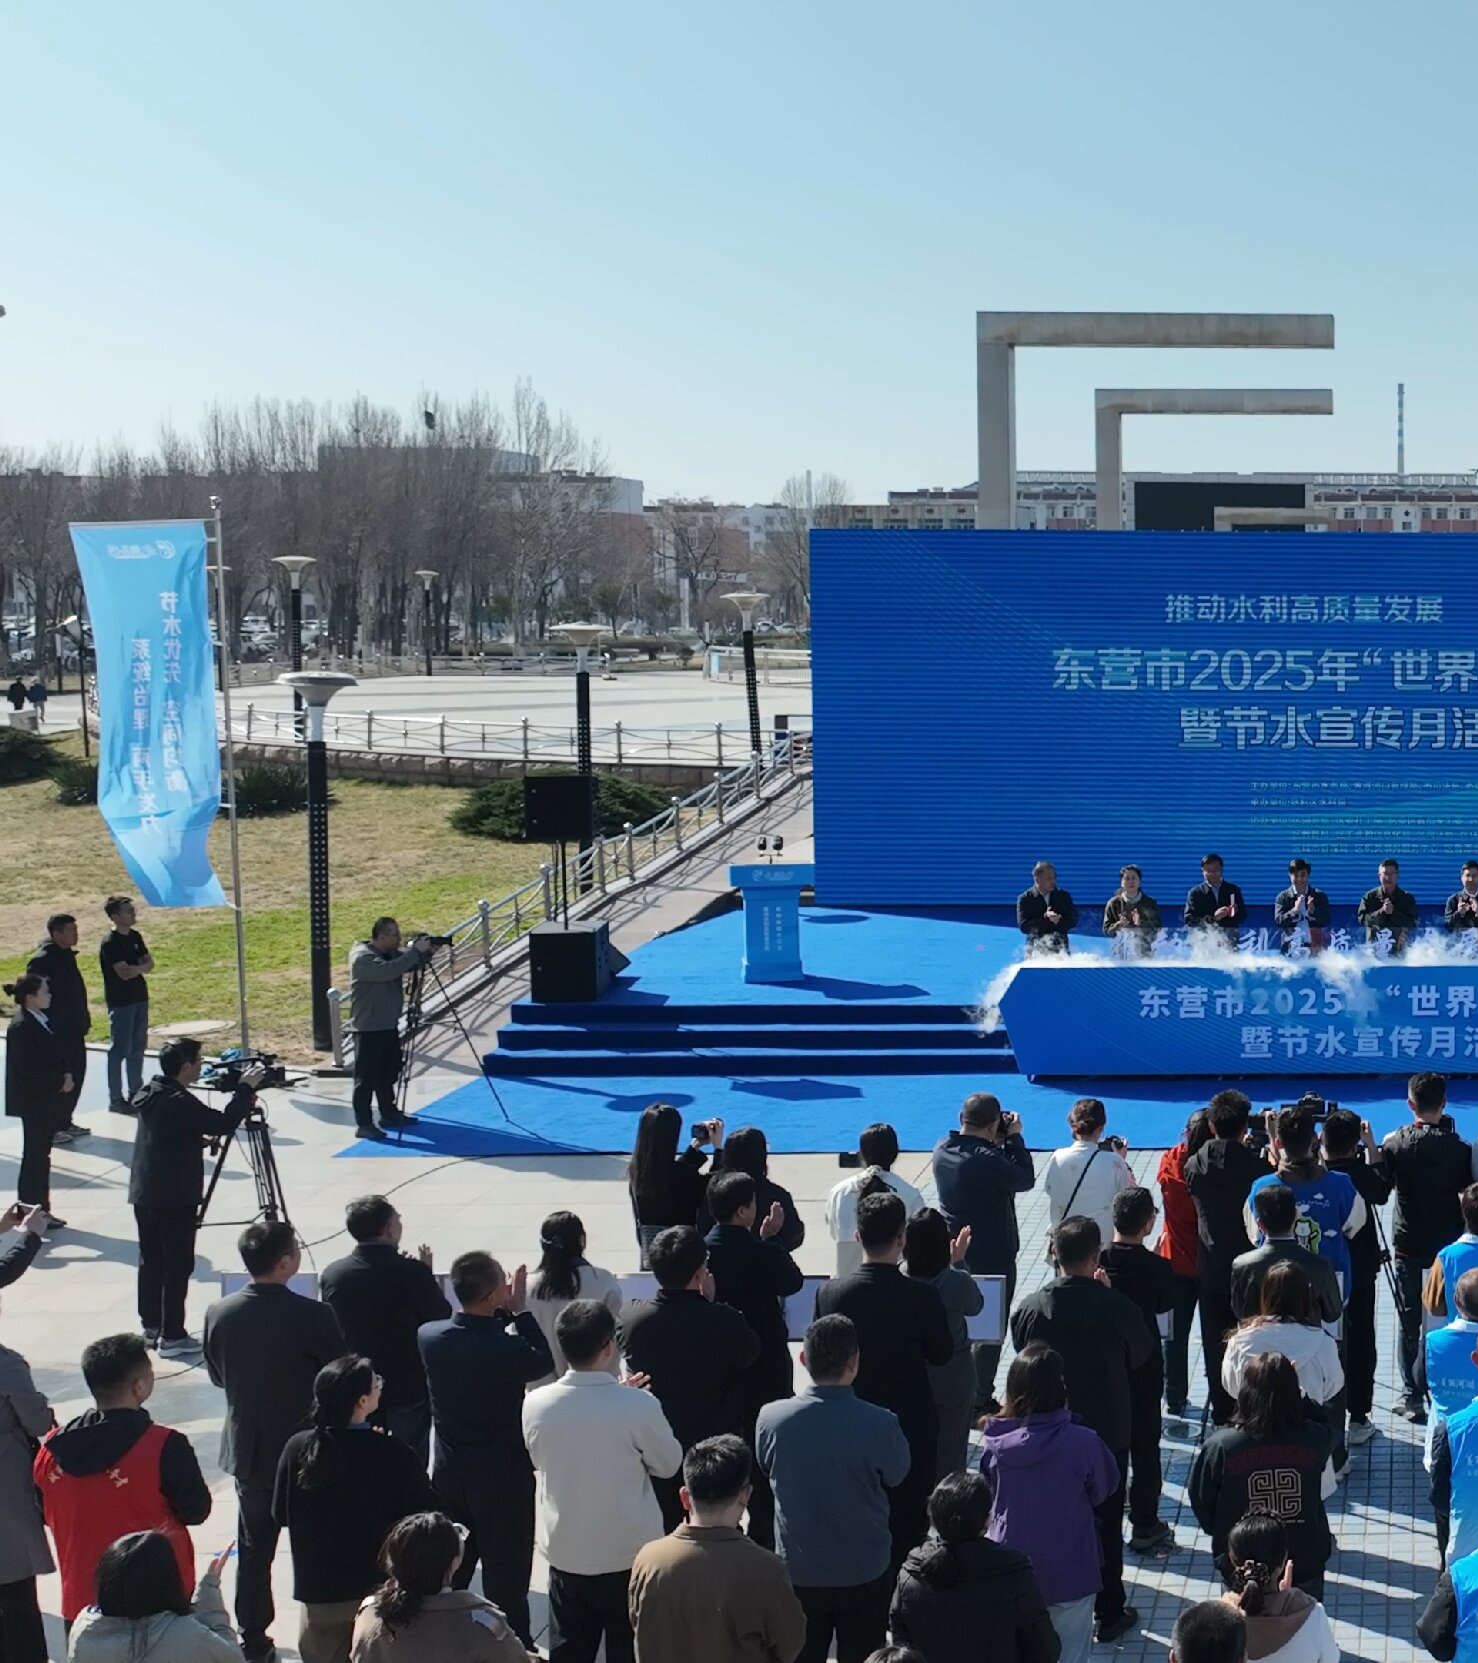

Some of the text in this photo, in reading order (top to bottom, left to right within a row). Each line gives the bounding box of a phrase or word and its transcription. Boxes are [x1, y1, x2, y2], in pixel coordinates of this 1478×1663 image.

[1164, 594, 1444, 624] 推动水利高质量发展
